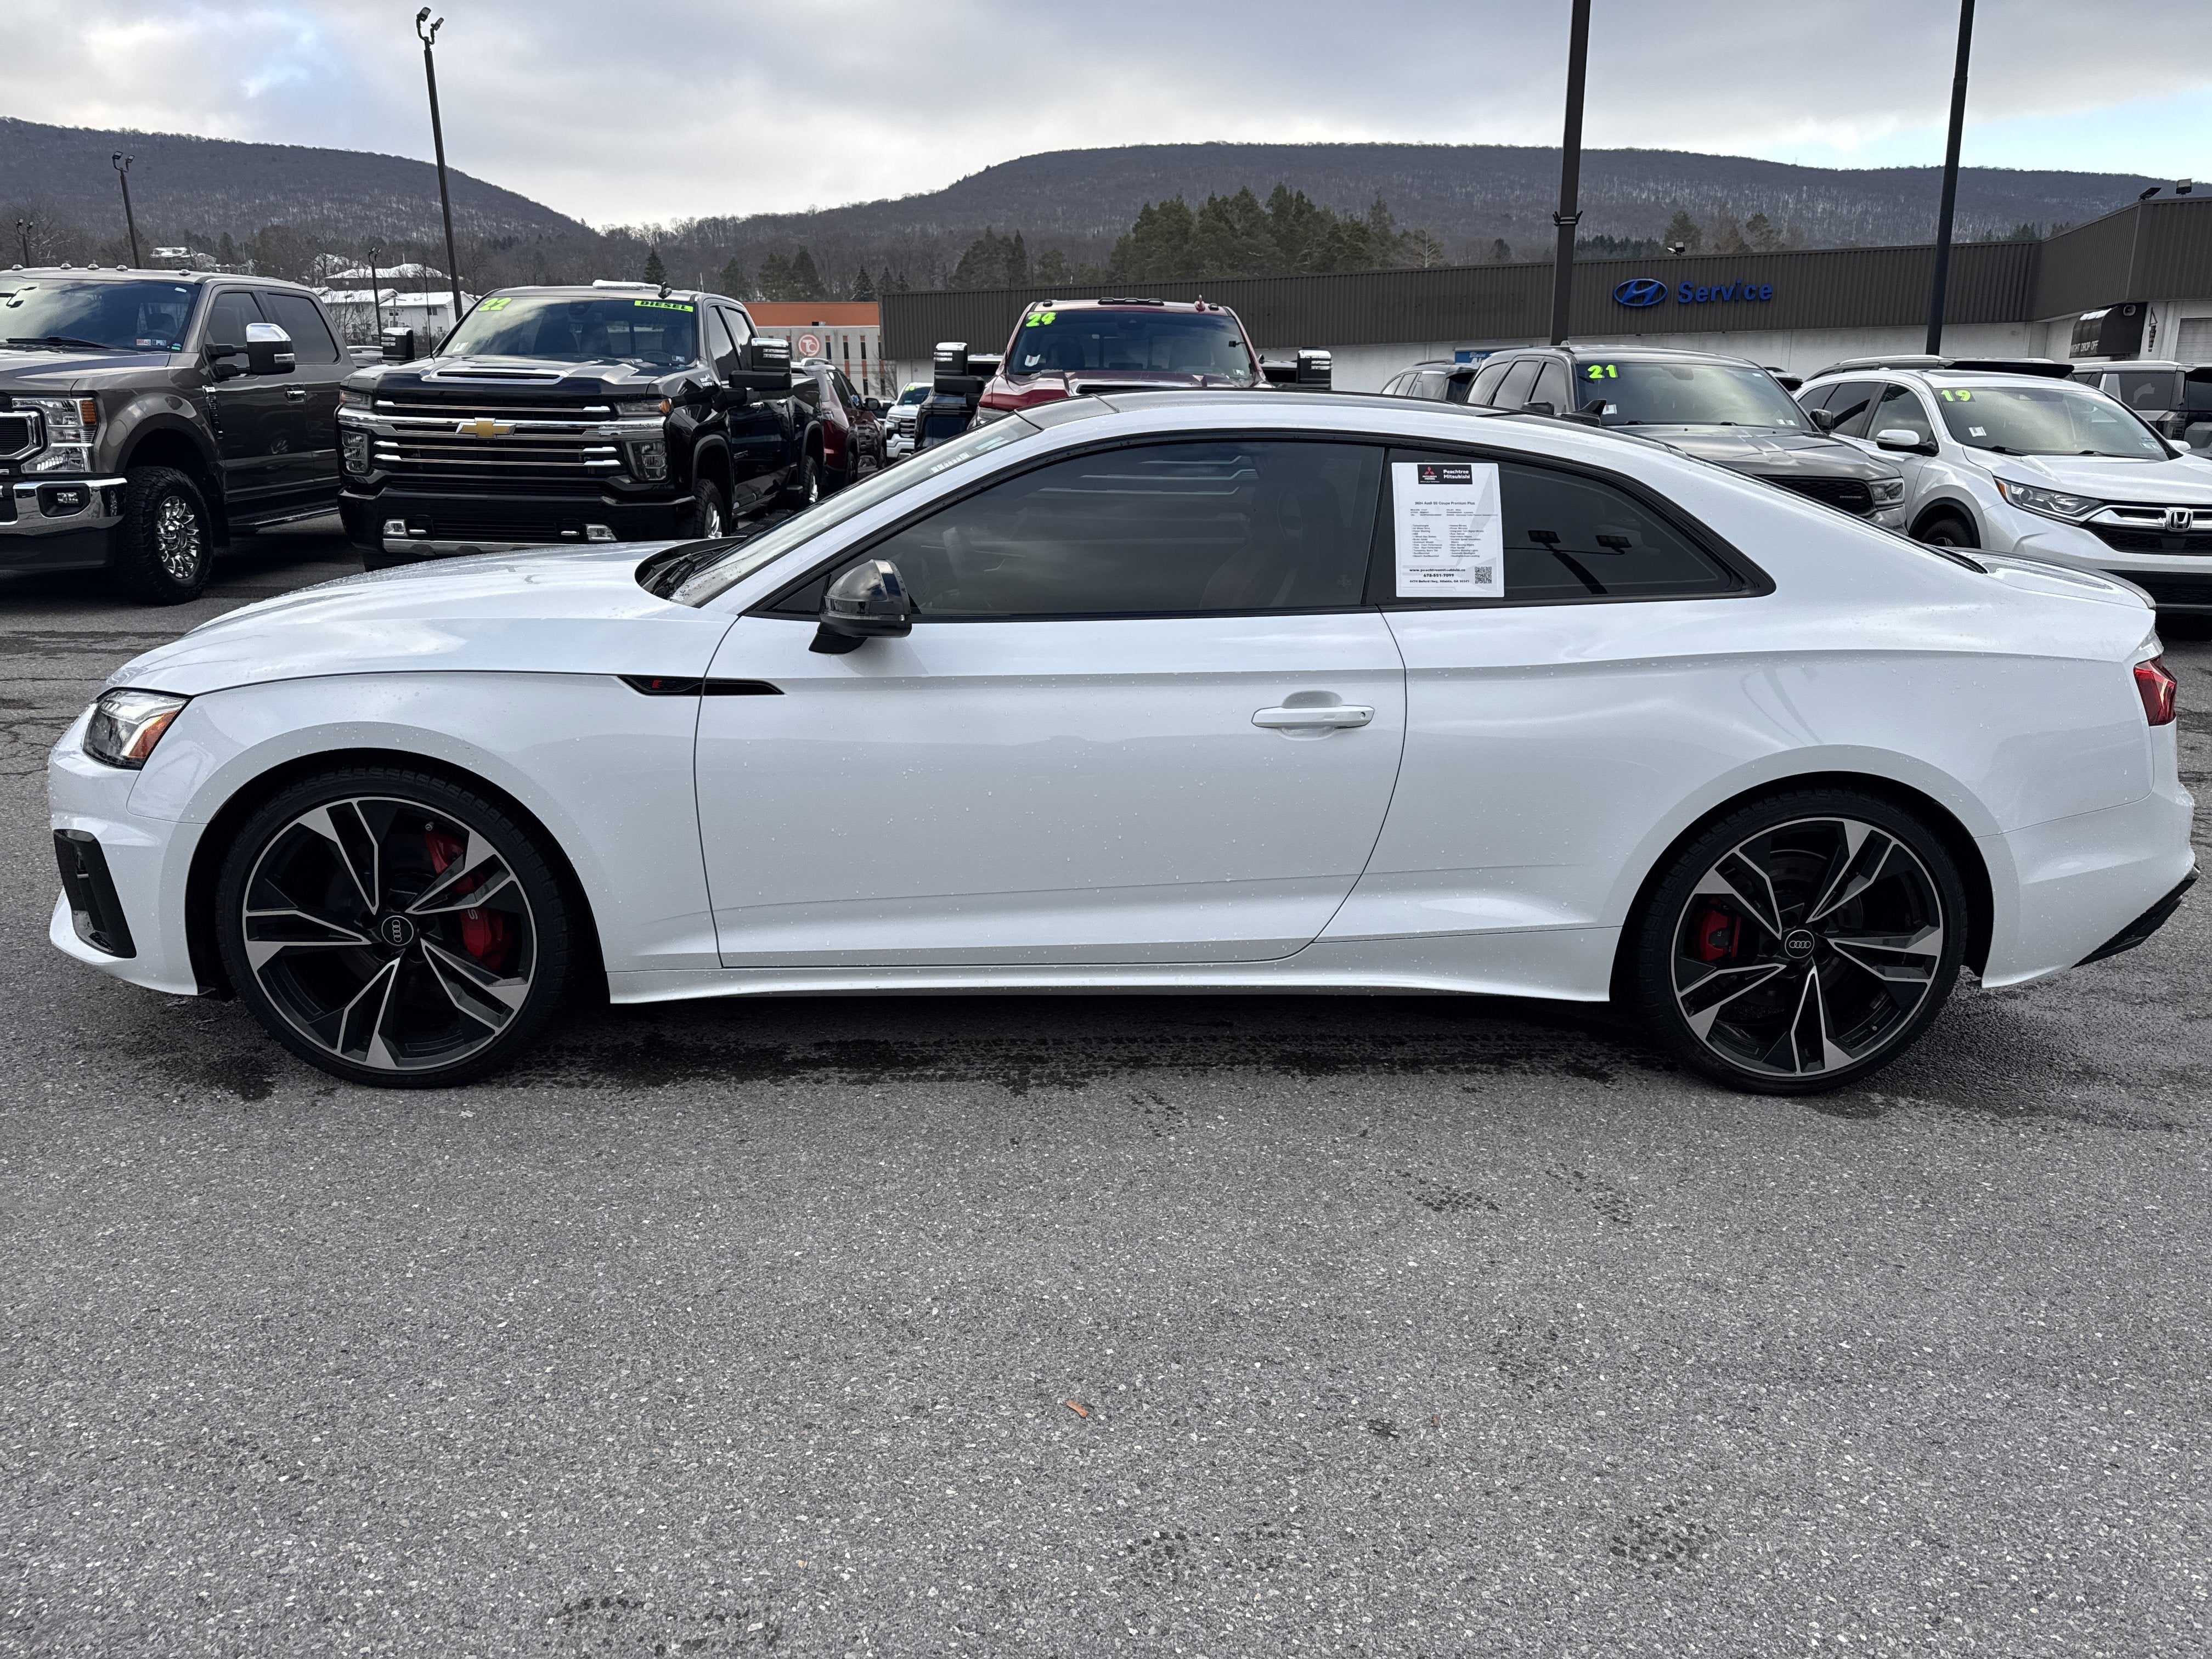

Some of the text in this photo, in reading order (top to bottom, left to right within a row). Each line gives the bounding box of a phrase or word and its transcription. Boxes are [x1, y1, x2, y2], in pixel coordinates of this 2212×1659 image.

[1677, 278, 1774, 303] Service
[478, 297, 512, 311] 22
[640, 301, 689, 311] DIESEL
[1026, 312, 1056, 327] 24
[1587, 364, 1618, 379] 21
[1941, 390, 1971, 402] 19
